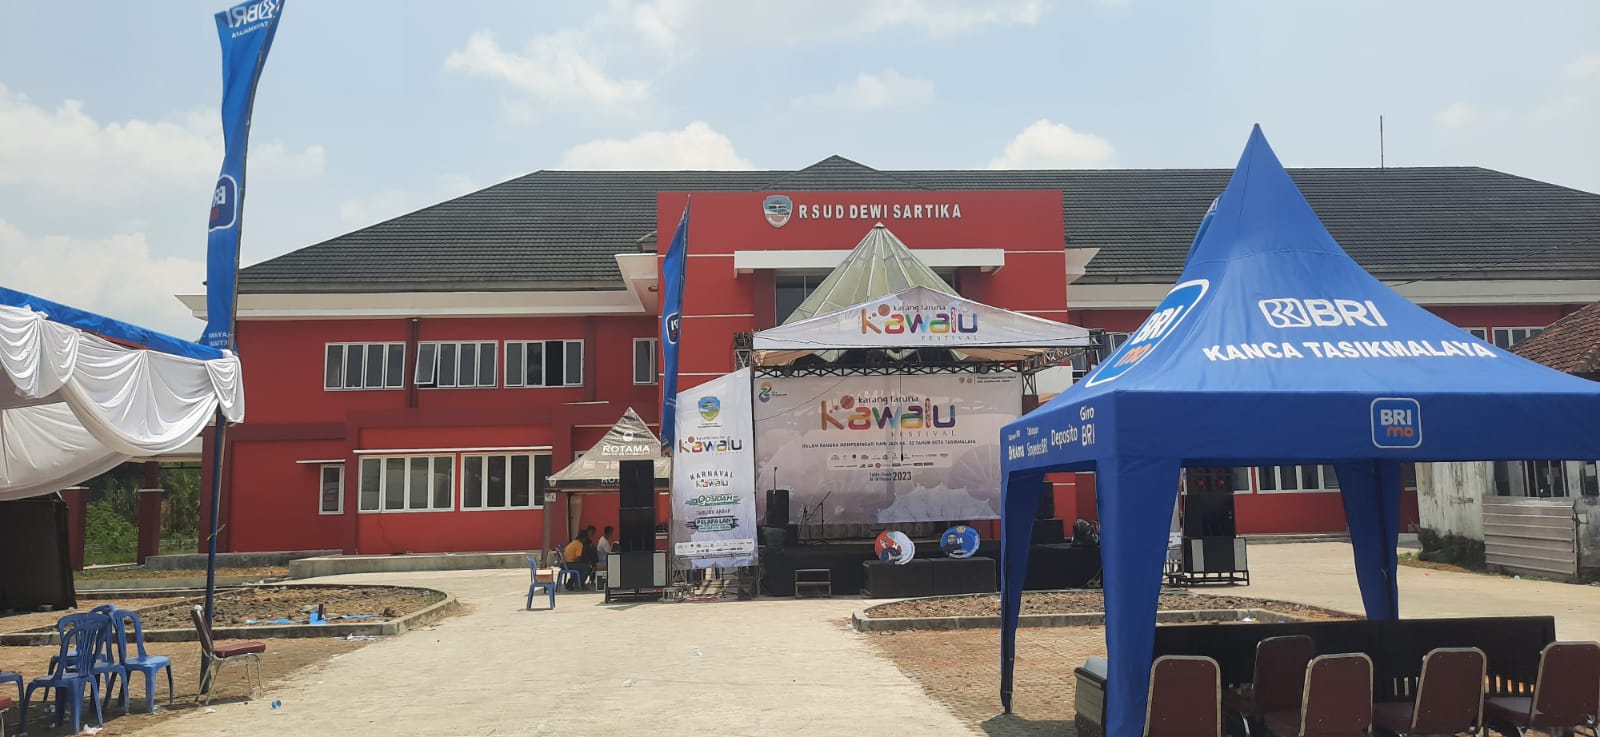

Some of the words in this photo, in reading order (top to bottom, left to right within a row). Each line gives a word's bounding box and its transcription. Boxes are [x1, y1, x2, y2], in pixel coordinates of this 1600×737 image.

[799, 203, 844, 219] RSUD
[849, 203, 888, 219] DEWI
[893, 203, 962, 219] SARTIKA
[1309, 298, 1389, 328] BRI
[1129, 304, 1185, 346] BRI
[1112, 343, 1152, 368] mo
[1202, 341, 1304, 361] KANCA
[1303, 340, 1497, 359] TASIKMALAYA
[1079, 405, 1095, 421] Giro
[1380, 408, 1413, 426] BRI
[1050, 423, 1078, 450] Deposito
[1081, 423, 1096, 447] BRI
[1386, 426, 1415, 438] mo
[602, 444, 651, 453] ROTAMA
[689, 470, 735, 481] KARNAVAL
[892, 471, 912, 481] 2023
